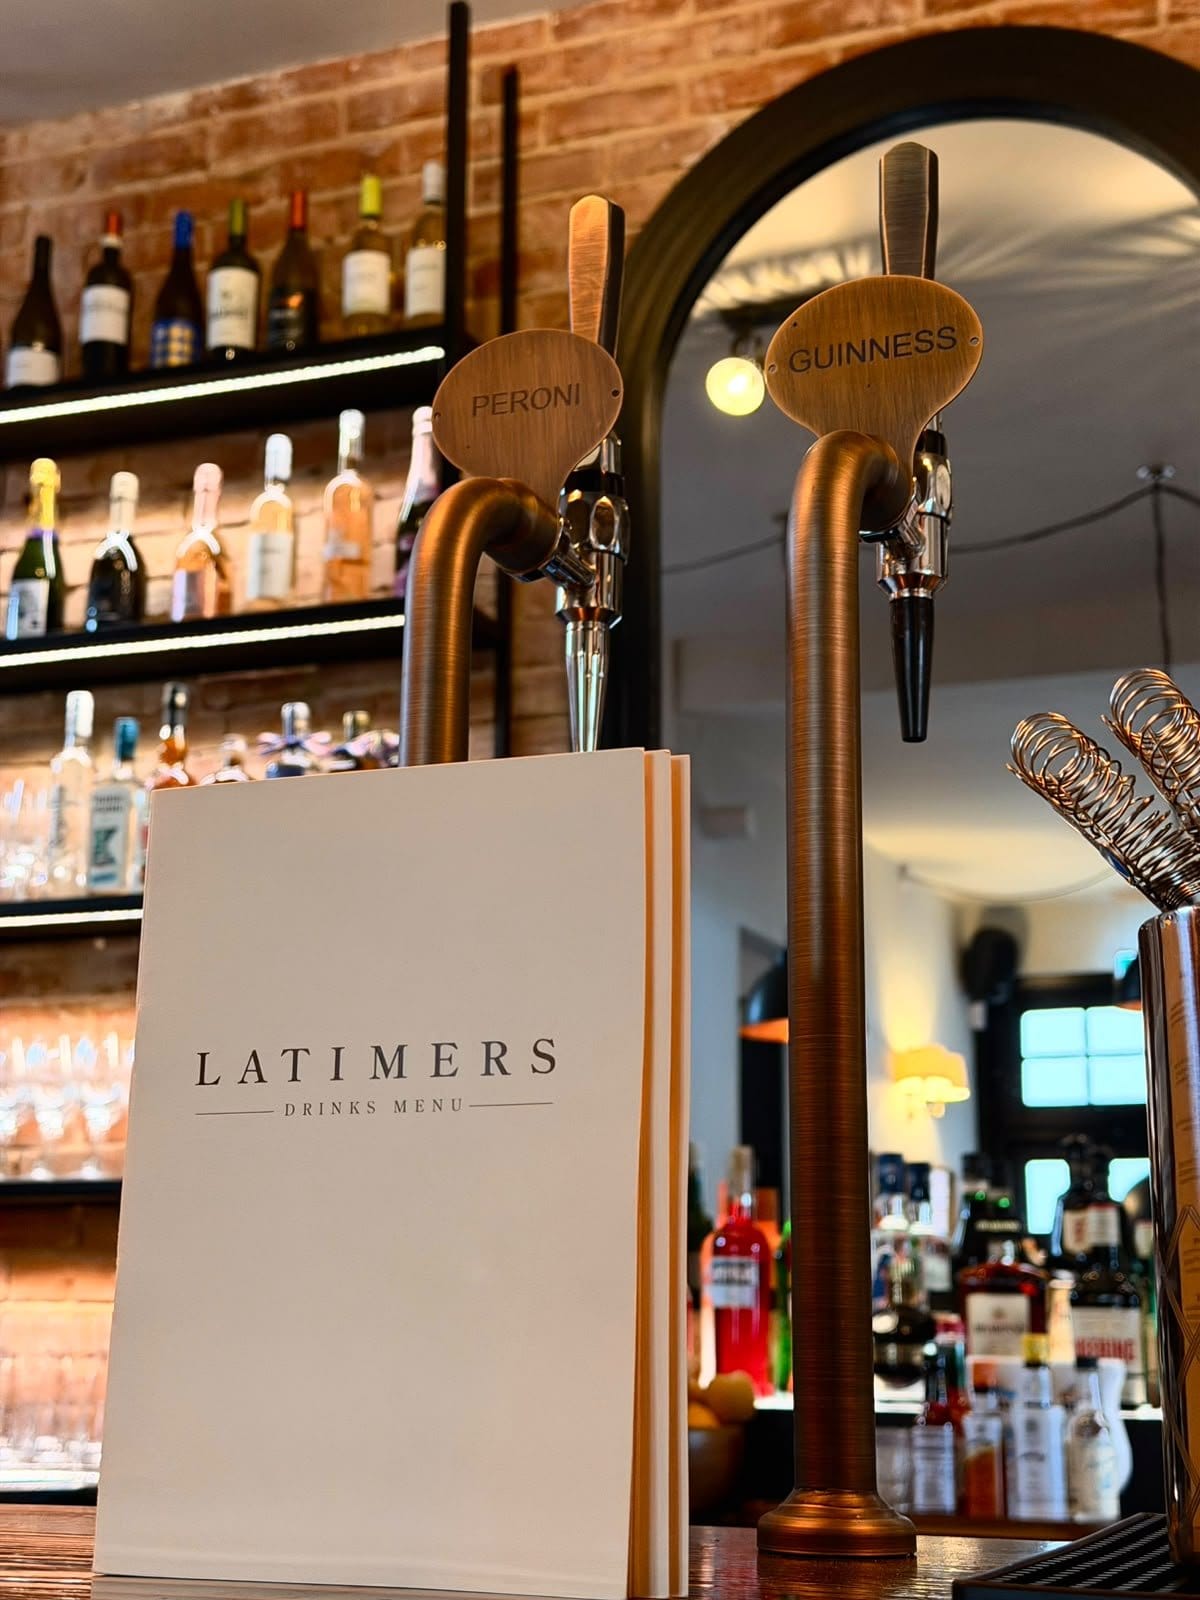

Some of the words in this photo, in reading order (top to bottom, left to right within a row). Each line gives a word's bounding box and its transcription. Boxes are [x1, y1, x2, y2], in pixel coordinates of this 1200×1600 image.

[788, 325, 958, 375] GUINNESS
[471, 382, 581, 418] PERONI
[194, 1037, 557, 1087] LATIMERS
[284, 1100, 376, 1117] DRINKS
[393, 1097, 464, 1114] MENU
